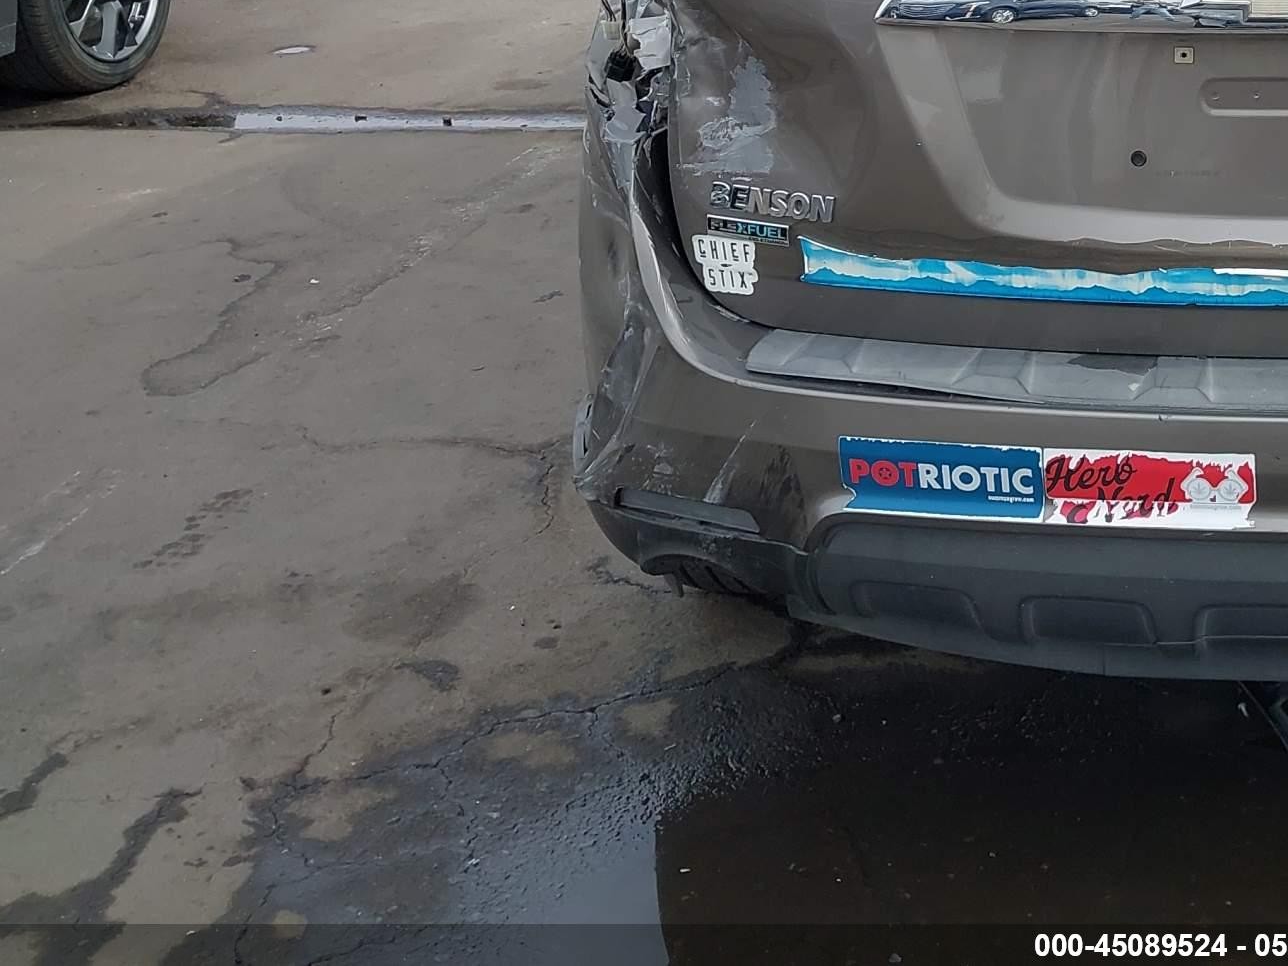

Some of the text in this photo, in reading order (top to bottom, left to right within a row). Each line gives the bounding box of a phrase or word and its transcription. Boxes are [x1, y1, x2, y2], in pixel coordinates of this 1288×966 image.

[709, 181, 837, 224] BENSON
[697, 238, 752, 263] CHIEF
[848, 457, 1034, 494] POTRIOTIC
[1045, 451, 1137, 493] Herb
